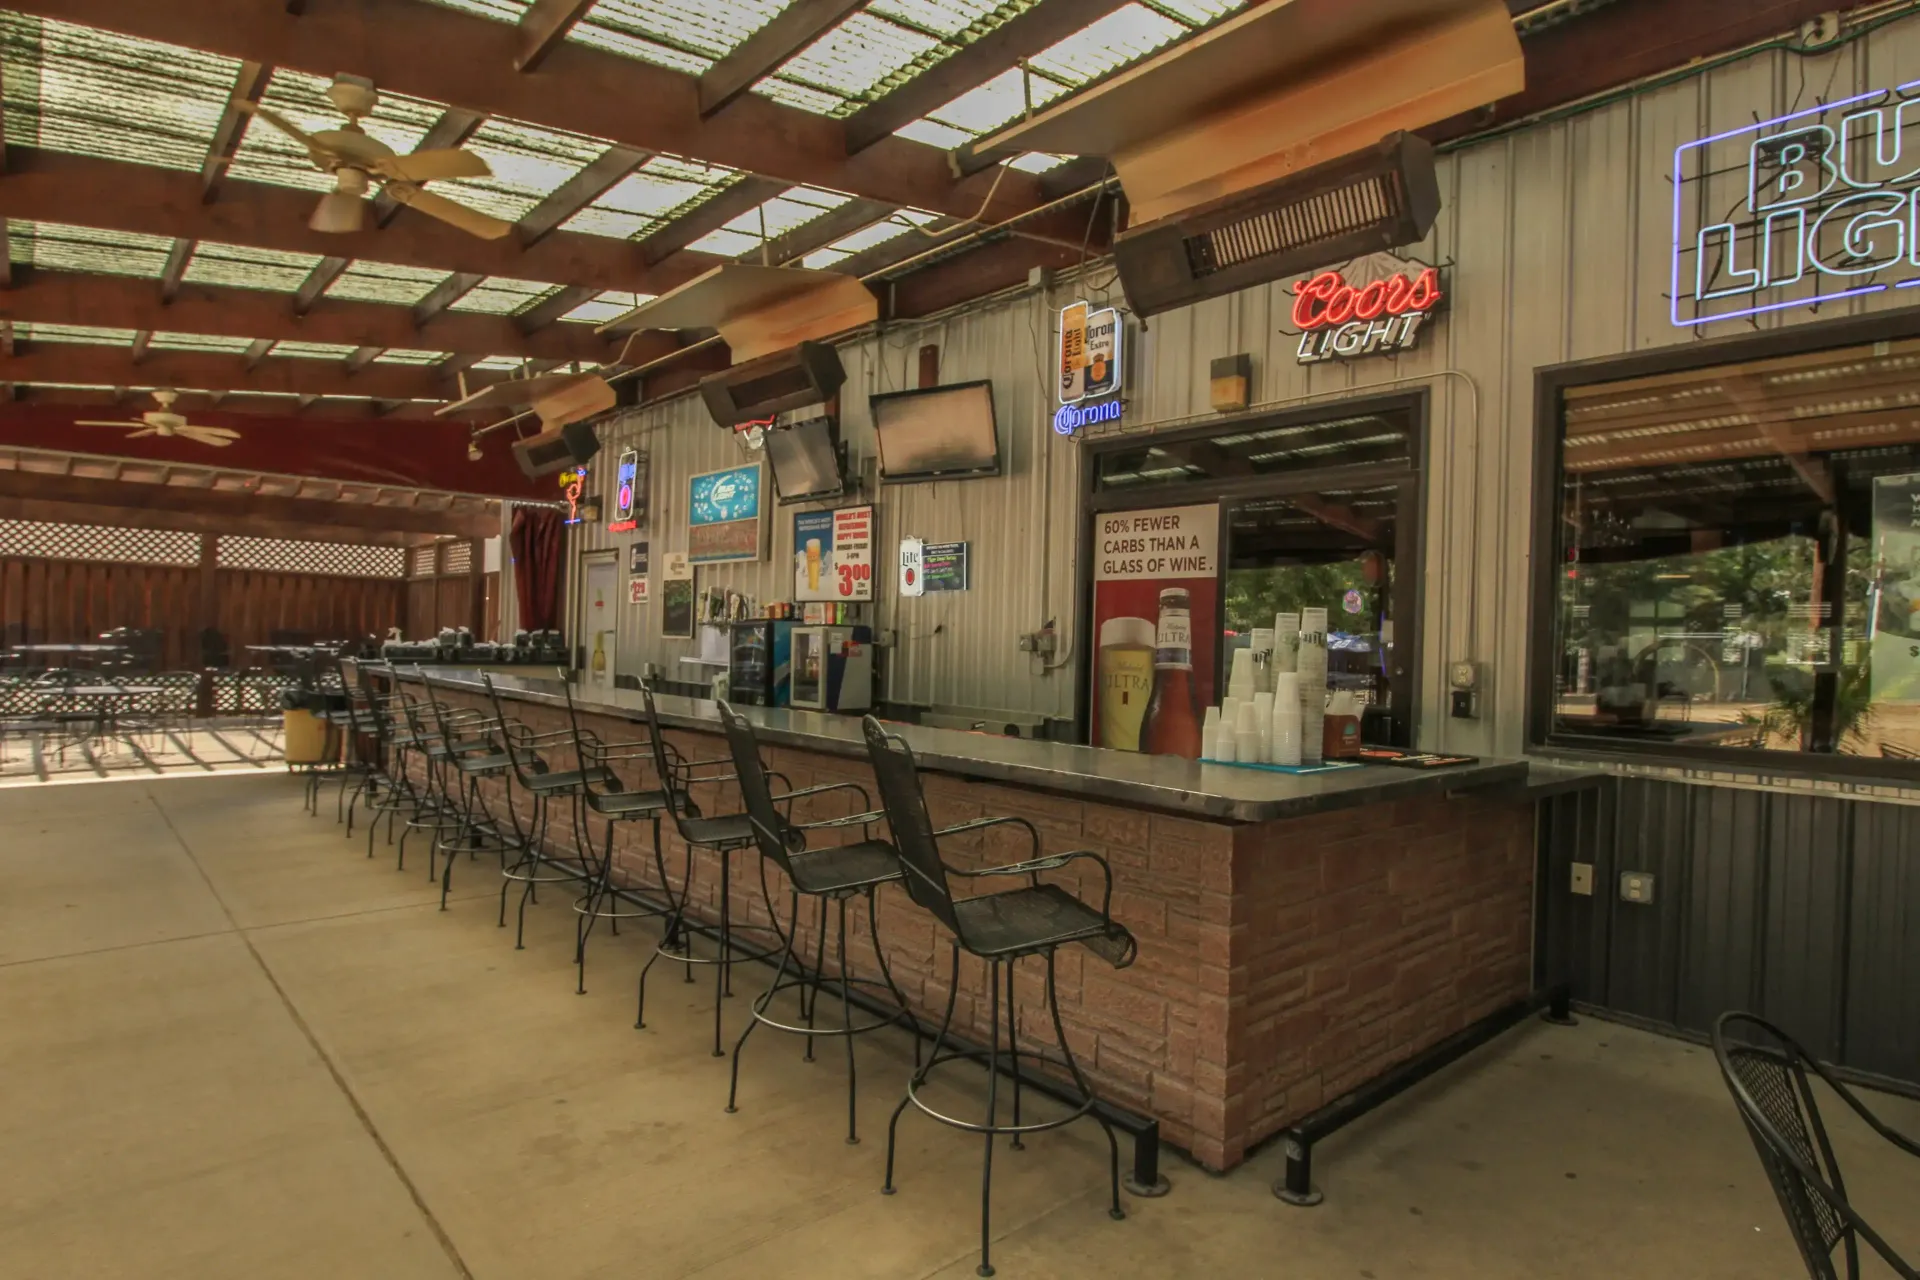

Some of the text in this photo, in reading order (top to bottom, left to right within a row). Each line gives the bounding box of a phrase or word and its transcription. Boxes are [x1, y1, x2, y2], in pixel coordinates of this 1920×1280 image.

[1696, 187, 1920, 300] LIG
[1291, 267, 1441, 331] Coors
[1090, 340, 1110, 351] Extra
[1296, 311, 1424, 363] LIGHT
[1063, 329, 1075, 390] Corona
[1054, 400, 1121, 435] Corona
[1104, 515, 1181, 534] 60% FEWER
[1104, 534, 1200, 554] CARBS THAN A
[902, 551, 919, 567] Lite
[1103, 559, 1143, 574] GLASS
[1146, 558, 1166, 573] OF
